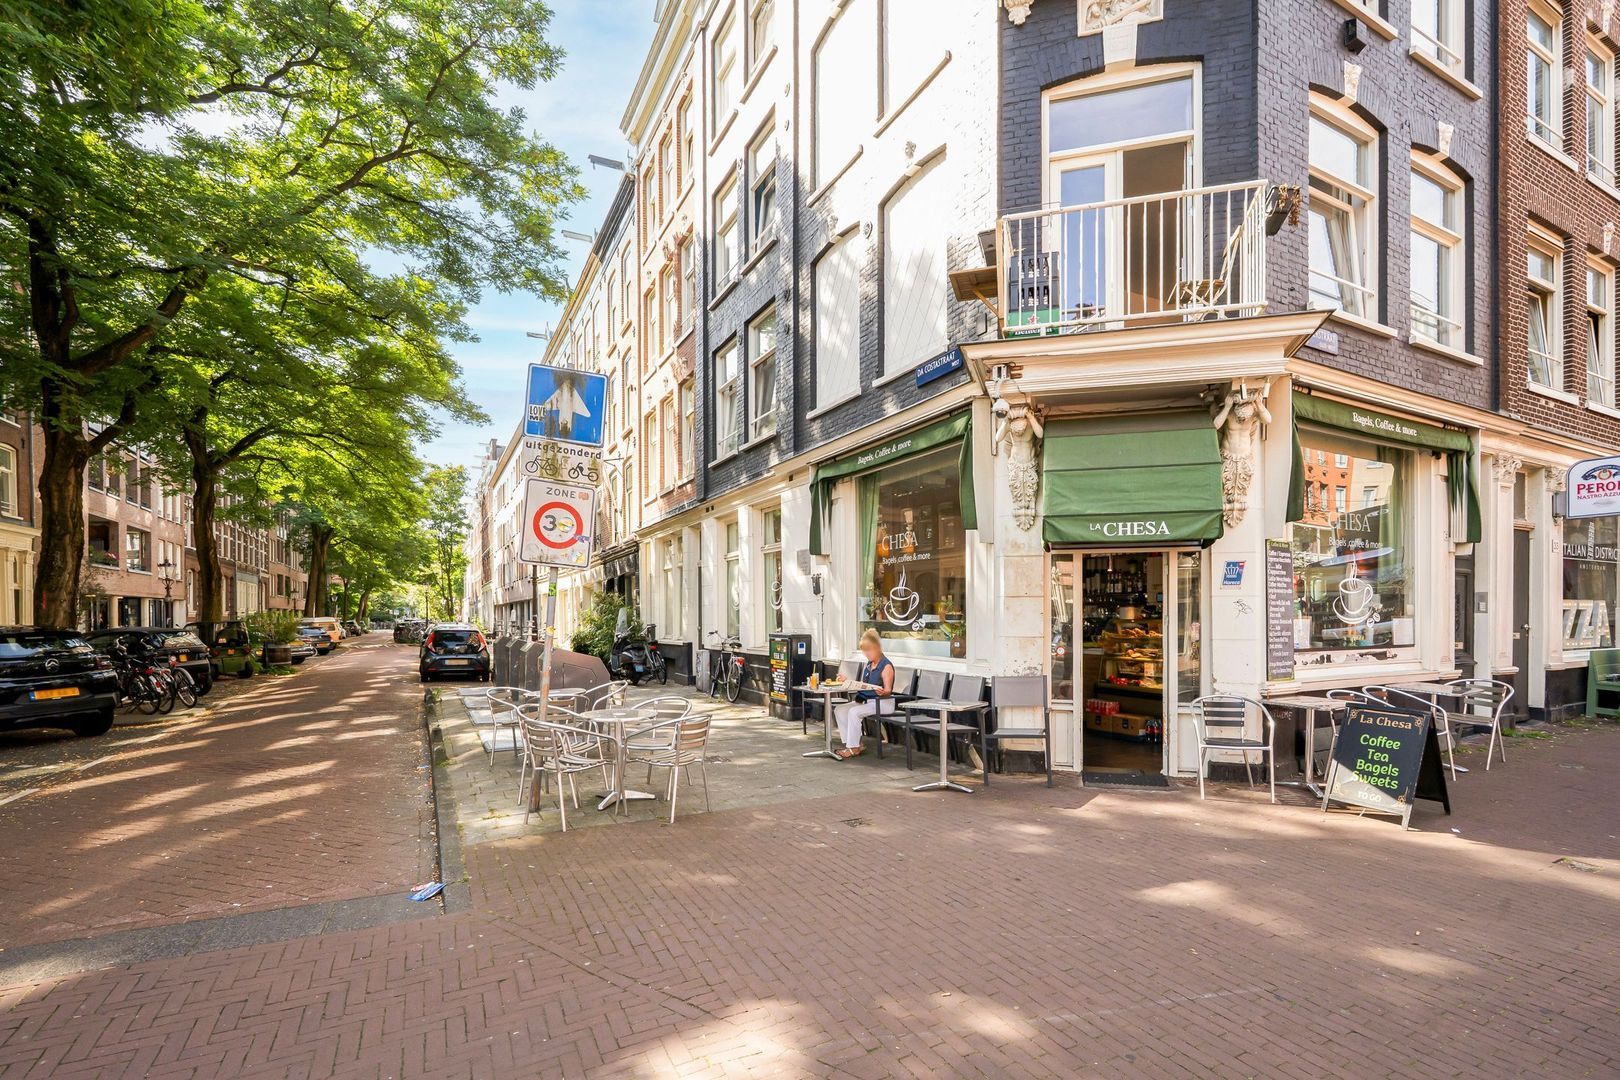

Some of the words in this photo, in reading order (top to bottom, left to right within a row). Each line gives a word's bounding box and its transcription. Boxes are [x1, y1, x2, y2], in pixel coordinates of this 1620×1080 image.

[917, 368, 924, 377] DA
[924, 351, 956, 374] COSTASTRAAT
[530, 406, 546, 417] LOVE
[1375, 418, 1395, 432] Coffee
[1395, 422, 1402, 433] &
[1402, 426, 1418, 436] more
[525, 441, 602, 460] uitgezonderd
[875, 446, 891, 459] Coffee
[891, 443, 897, 453] &
[897, 440, 912, 450] more
[546, 487, 577, 499] ZONE
[1577, 481, 1620, 495] PERO
[1089, 523, 1101, 531] LA
[1103, 521, 1170, 537] CHESA
[1328, 512, 1371, 532] CHESA
[881, 531, 918, 551] CHESA
[1365, 540, 1370, 549] &
[1360, 714, 1373, 724] La
[1376, 717, 1412, 730] Chesa
[1360, 734, 1401, 750] Coffee
[1367, 749, 1389, 763] Tea
[1355, 759, 1399, 777] Bagels
[1351, 771, 1399, 789] Sweets
